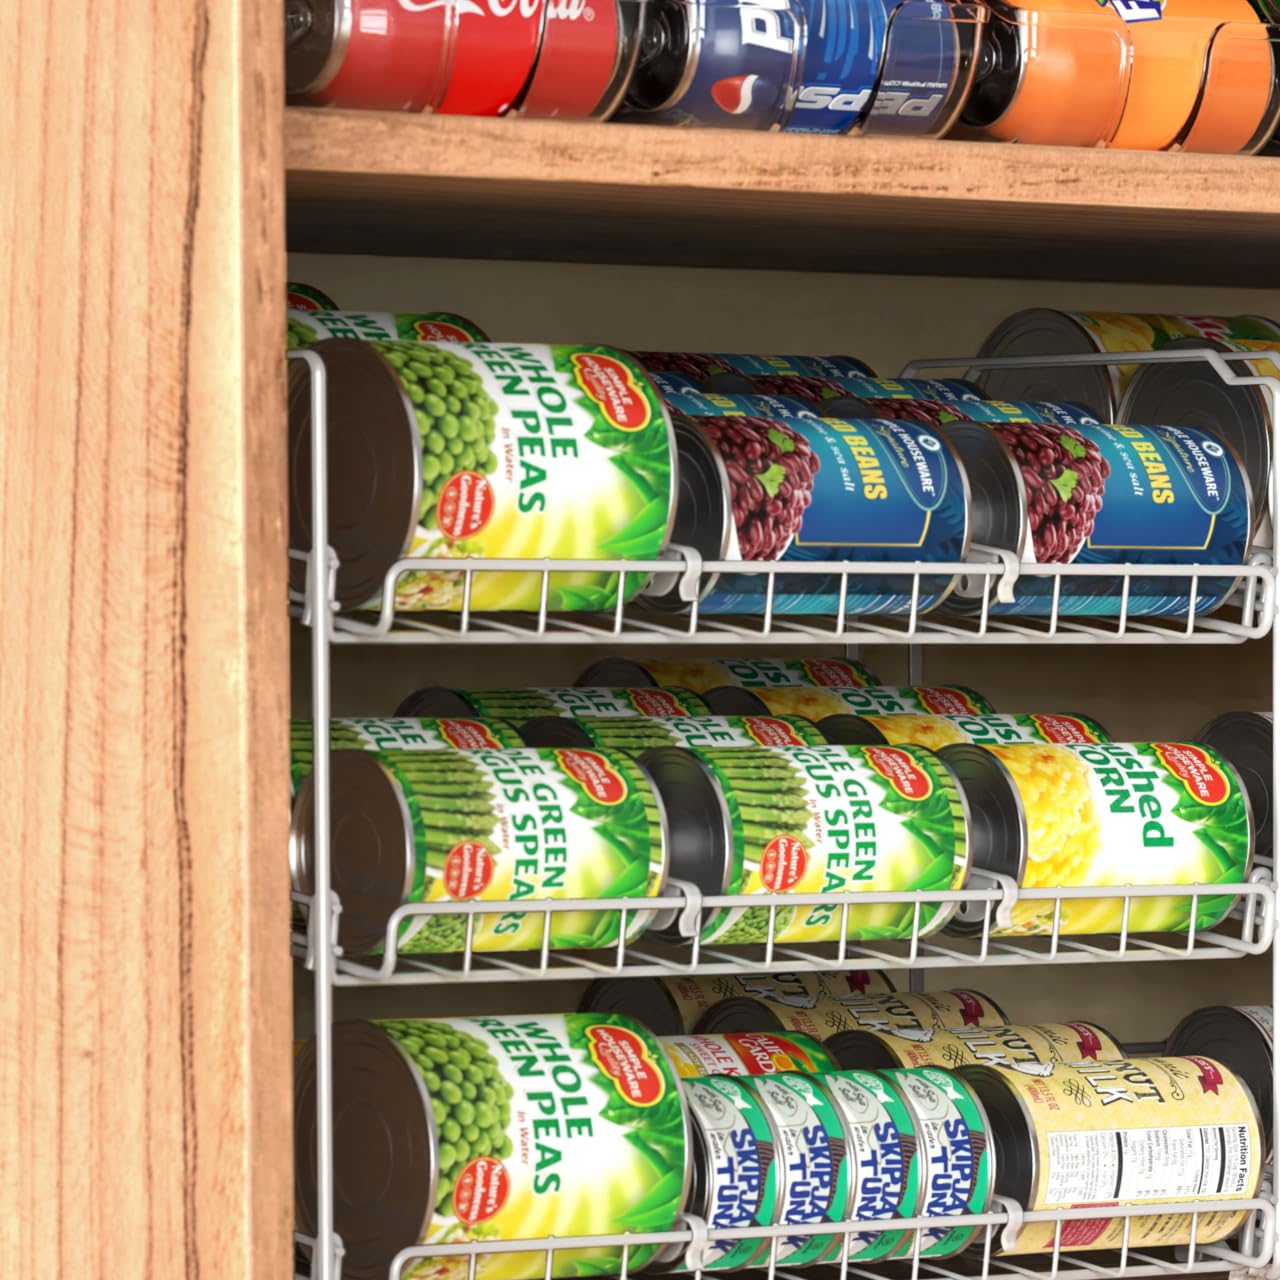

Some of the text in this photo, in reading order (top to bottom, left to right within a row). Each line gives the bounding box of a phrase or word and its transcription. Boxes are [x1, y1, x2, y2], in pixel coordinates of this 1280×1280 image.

[500, 346, 578, 458] WHOLE
[582, 356, 628, 423] HOUSEWARE
[603, 367, 633, 406] SIMPLE
[504, 442, 515, 482] Water
[511, 410, 547, 513] PEAS
[840, 467, 856, 492] salt
[842, 435, 888, 500] BEANS
[897, 431, 936, 494] HOUSEWARE
[1129, 471, 1145, 497] salt
[1130, 441, 1175, 504] BEANS
[1183, 437, 1219, 499] HOUSEWARE
[454, 475, 472, 537] Goodness
[470, 478, 487, 530] Nature's
[585, 757, 610, 785] SIMPLE
[888, 753, 916, 781] SIMPLE
[1073, 746, 1135, 814] CORN
[1182, 749, 1213, 782] SIMPLE
[532, 784, 567, 888] GREEN
[813, 810, 823, 845] Water
[843, 779, 876, 881] GREEN
[457, 843, 473, 898] Goodness
[773, 837, 788, 890] Goodness
[787, 841, 801, 884] Nature's
[516, 1021, 593, 1139] WHOLE
[596, 1028, 642, 1099] HOUSEWARE
[617, 1039, 648, 1081] SIMPLE
[519, 1126, 530, 1165] Water
[526, 1092, 563, 1196] PEAS
[1236, 1125, 1248, 1193] Nutrition Facts
[468, 1160, 488, 1221] Goodness
[486, 1163, 503, 1214] Nature's
